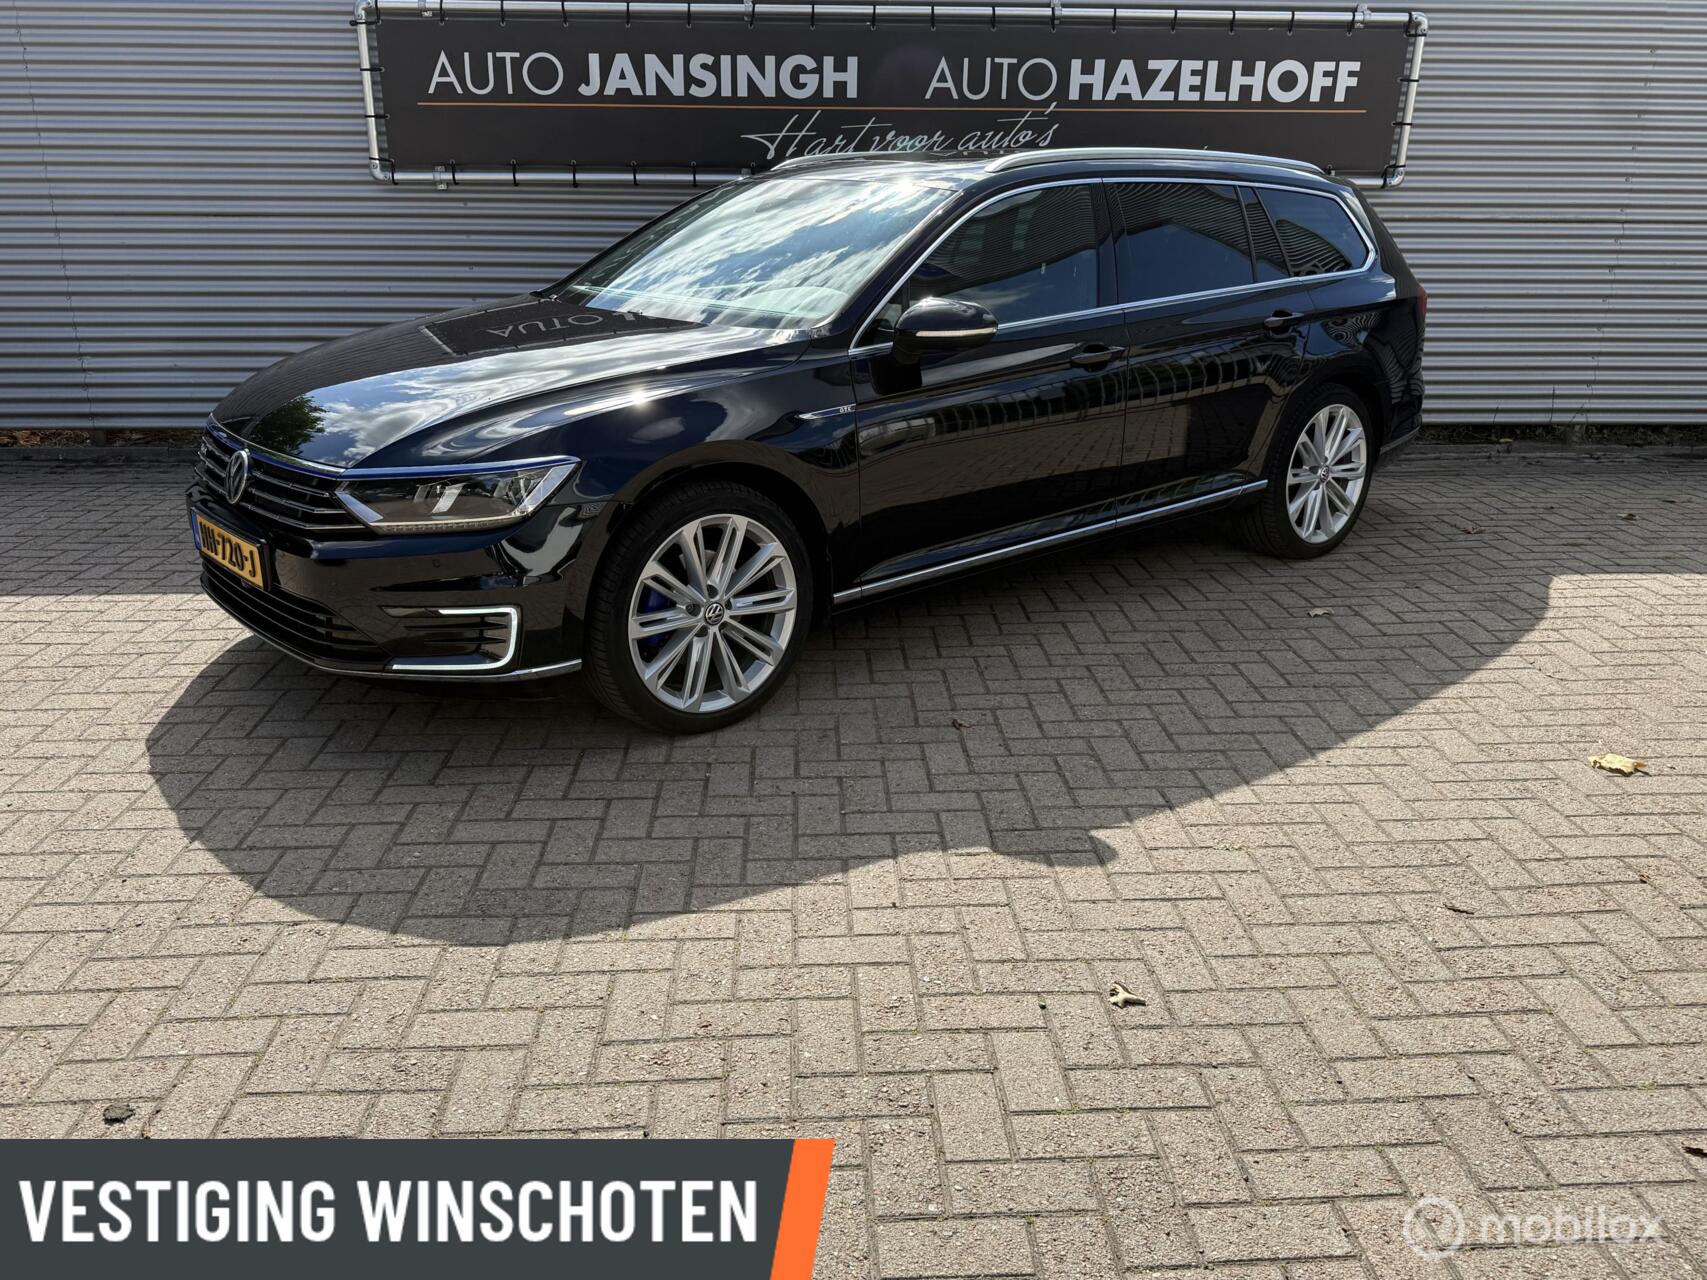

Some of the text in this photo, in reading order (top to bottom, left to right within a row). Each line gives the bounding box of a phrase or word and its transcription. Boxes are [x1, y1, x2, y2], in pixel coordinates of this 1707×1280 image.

[428, 49, 859, 99] AUTO JANSINGH
[925, 56, 1361, 103] AUTO HAZELHOFF
[740, 110, 892, 160] Hart
[873, 122, 953, 155] voor
